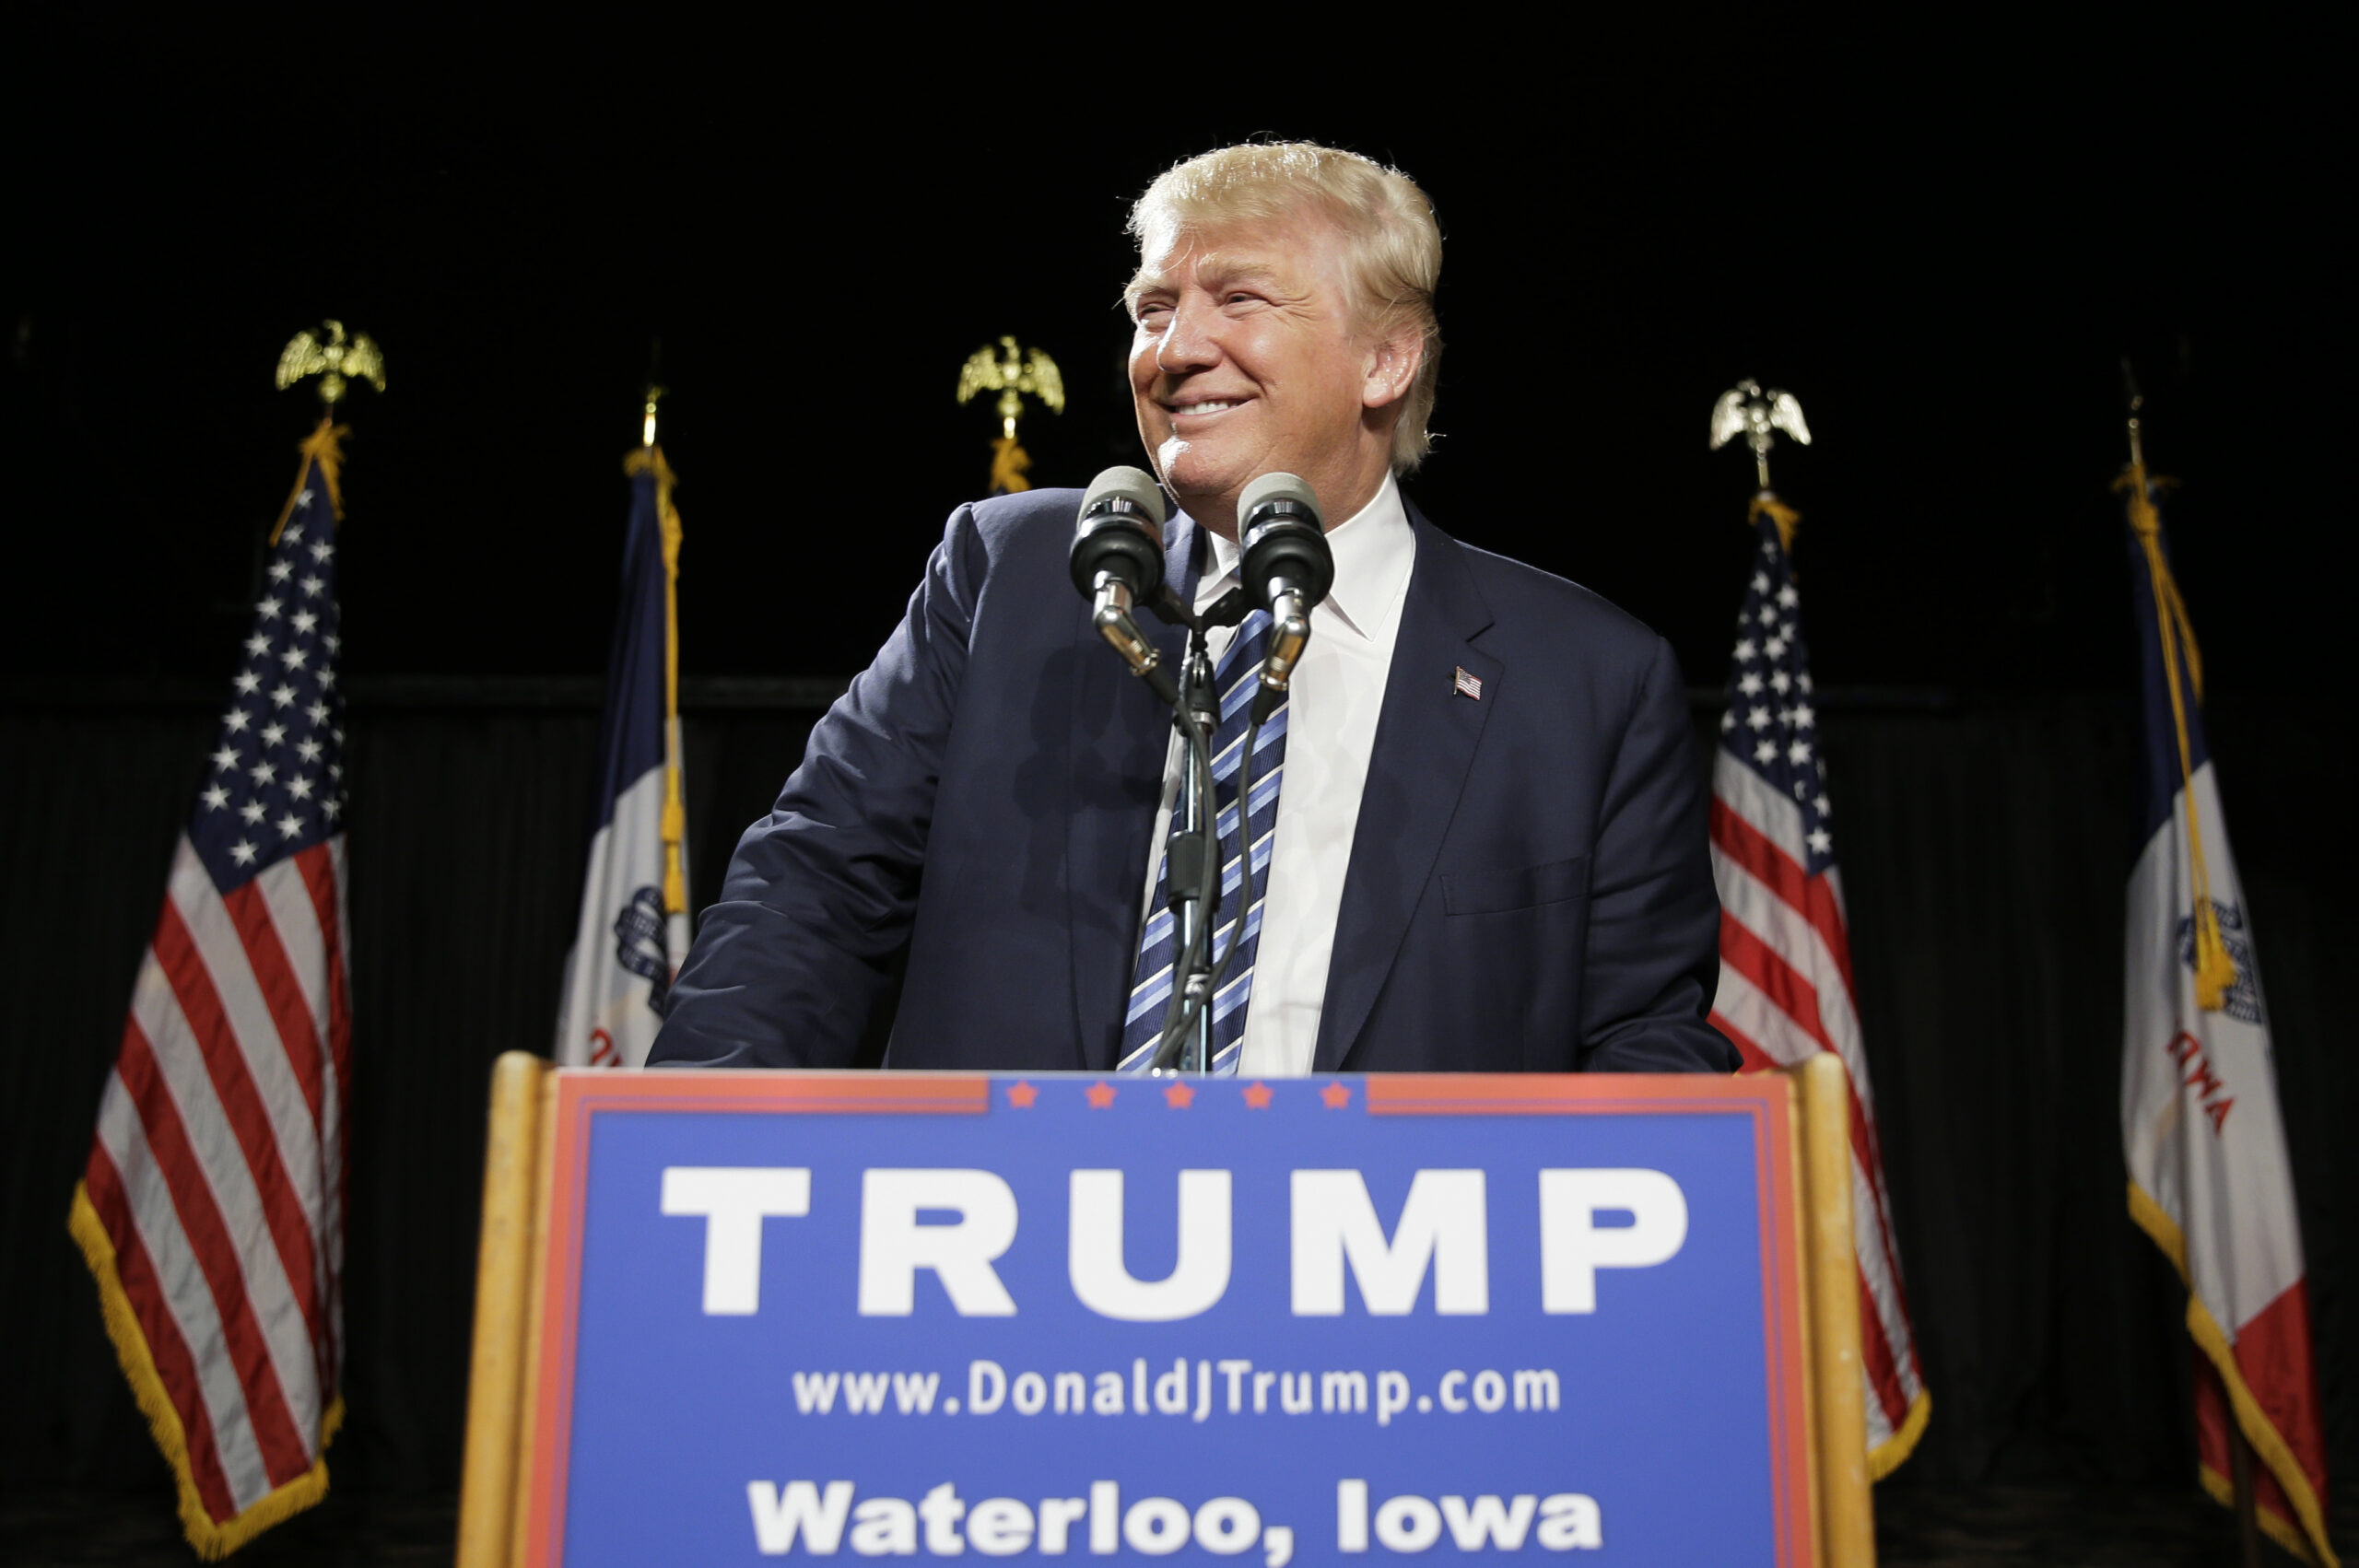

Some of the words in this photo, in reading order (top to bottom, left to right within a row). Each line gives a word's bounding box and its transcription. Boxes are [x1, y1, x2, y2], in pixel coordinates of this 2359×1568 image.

[659, 1165, 1689, 1323] TRUMP
[792, 1356, 1561, 1426] www.DonaldJTrump.com
[745, 1480, 1294, 1568] Waterloo,
[1336, 1478, 1603, 1553] Iowa
